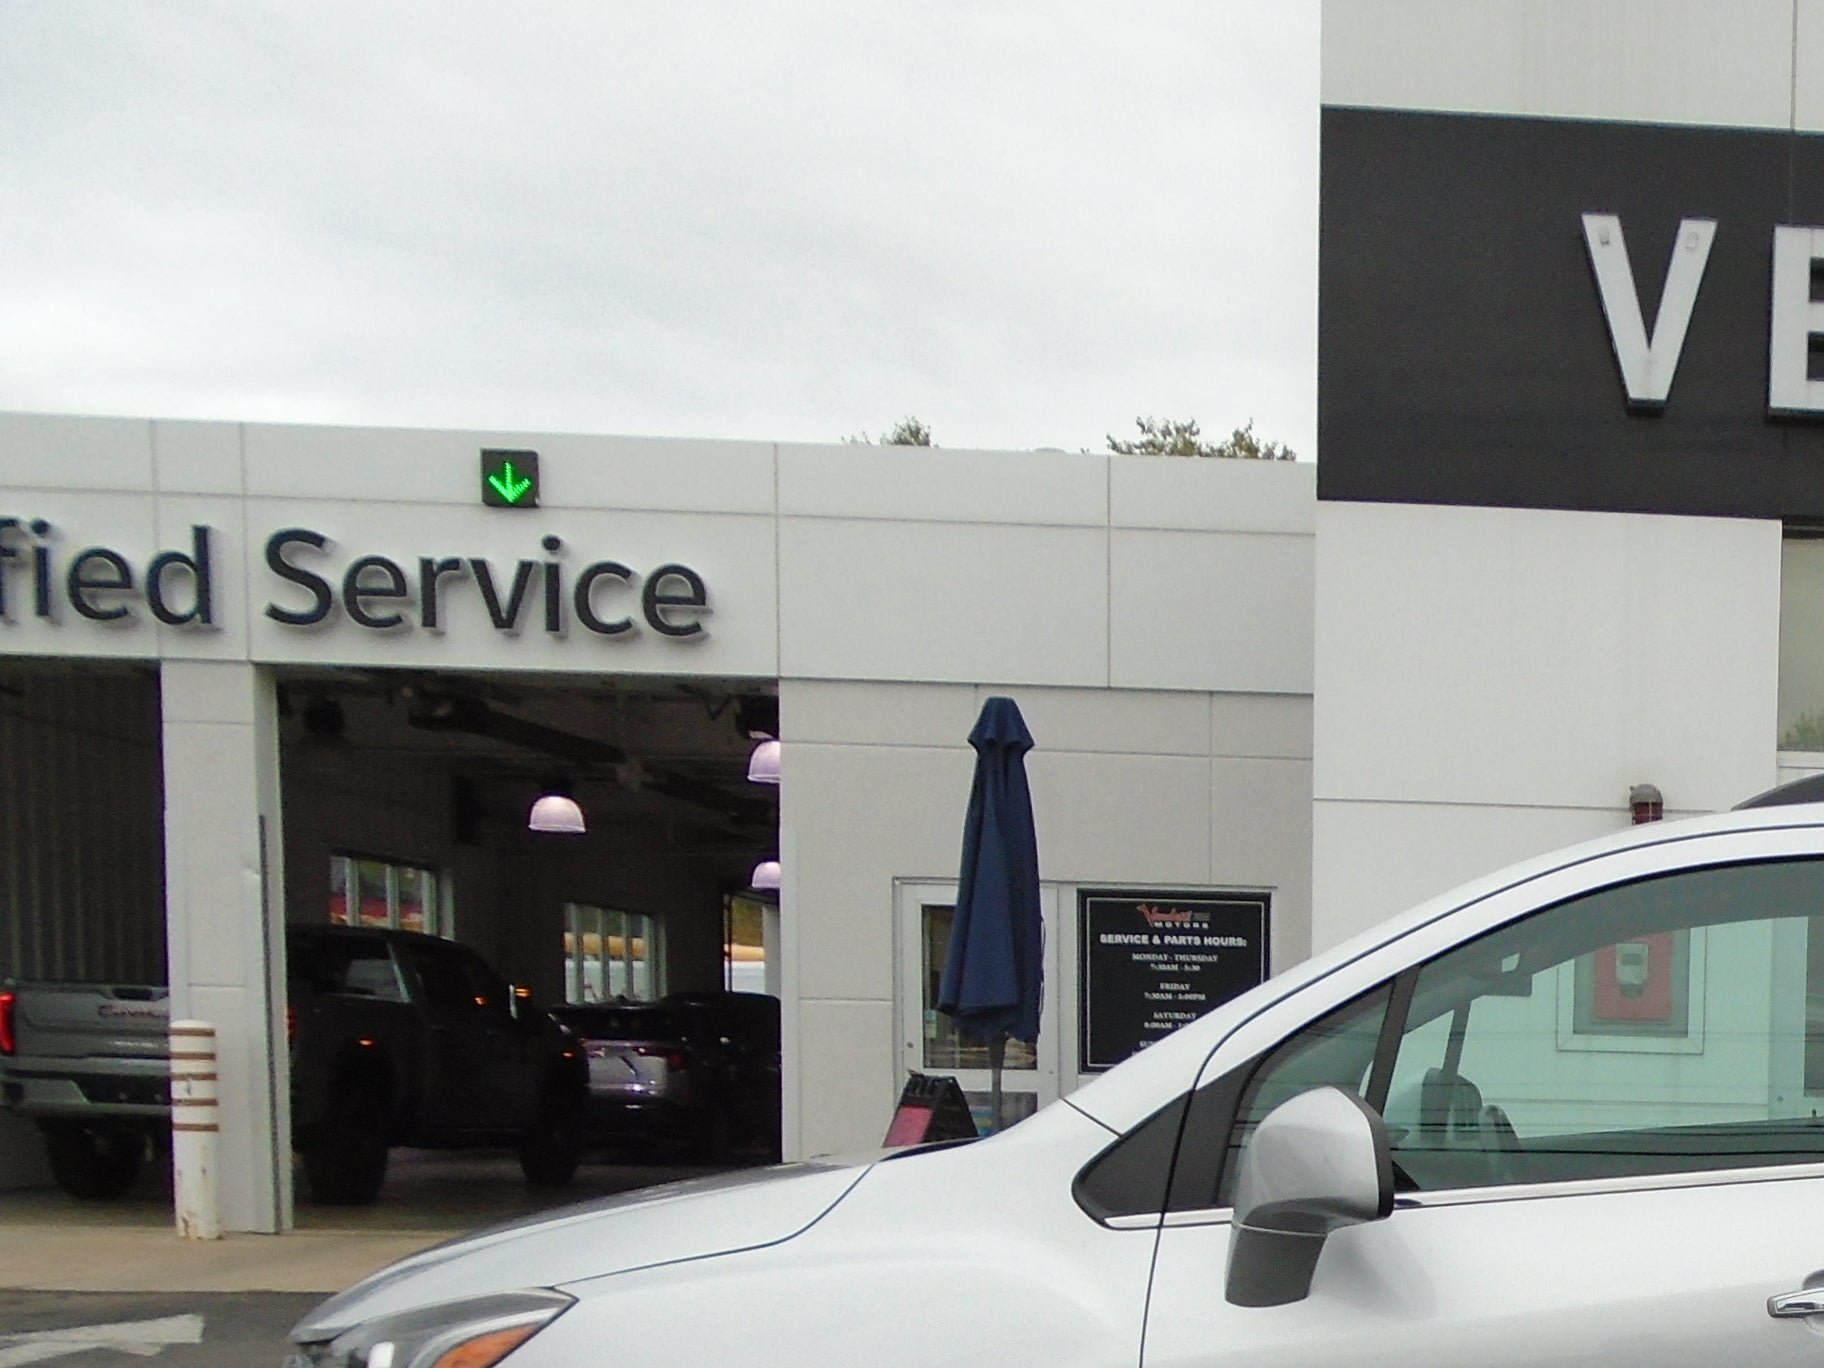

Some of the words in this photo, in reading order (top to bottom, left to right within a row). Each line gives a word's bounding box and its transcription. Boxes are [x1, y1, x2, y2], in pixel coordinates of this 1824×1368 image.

[264, 527, 709, 638] Service
[1154, 921, 1210, 929] MOTORS
[1100, 934, 1150, 945] SERVICE
[1152, 935, 1161, 945] &
[1164, 935, 1201, 946] PARTS
[1204, 936, 1248, 947] HOURS:
[1132, 953, 1168, 961] MONDAY
[1174, 953, 1219, 962] THURSDAY
[1160, 982, 1191, 990] FRIDAY
